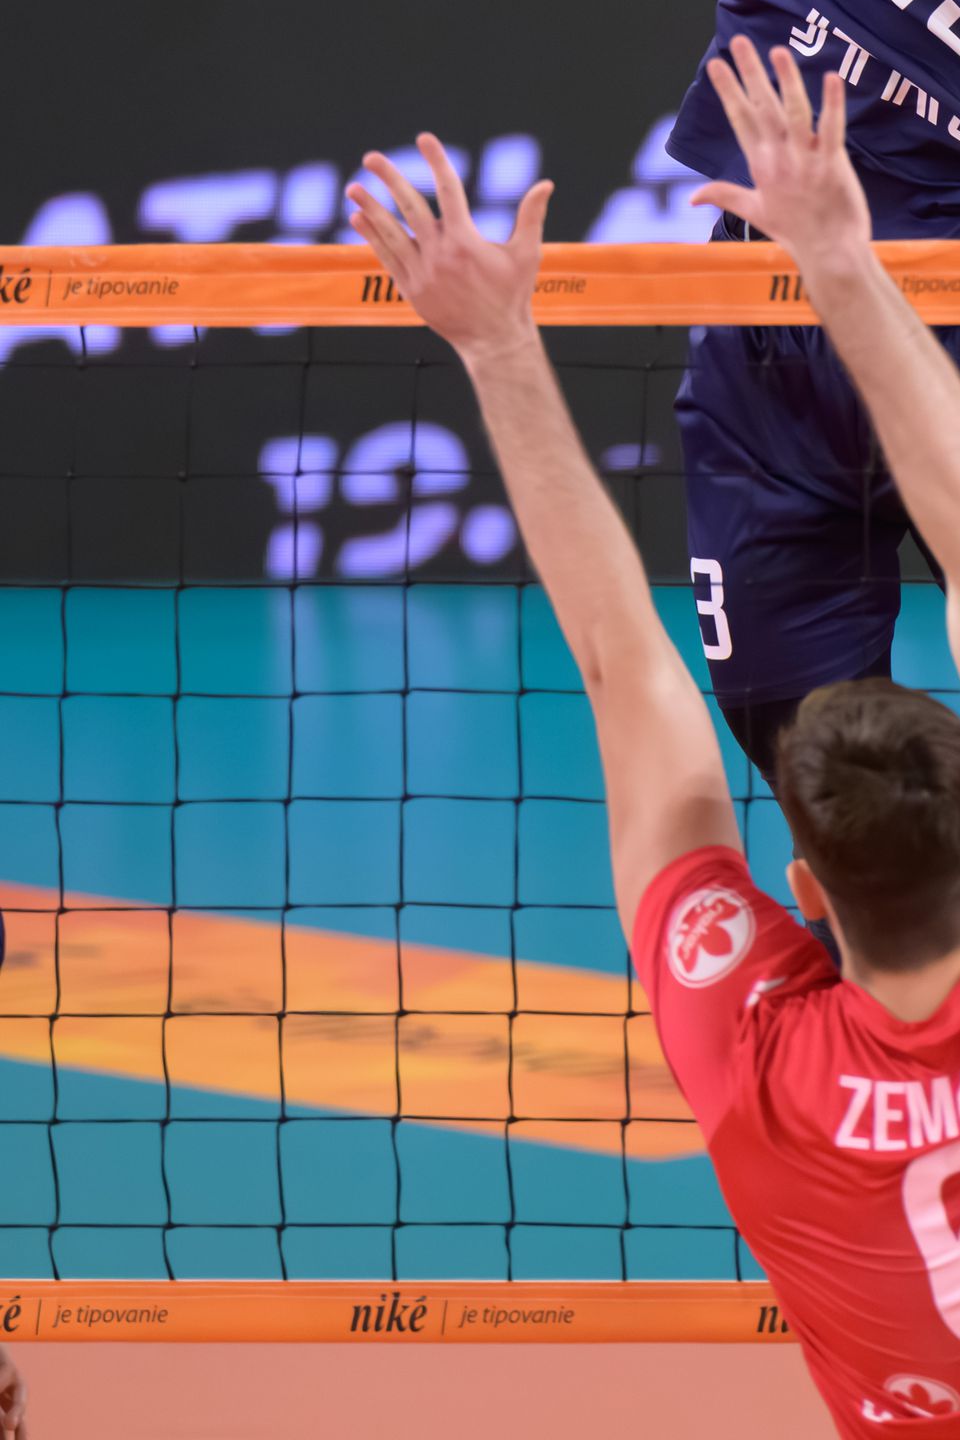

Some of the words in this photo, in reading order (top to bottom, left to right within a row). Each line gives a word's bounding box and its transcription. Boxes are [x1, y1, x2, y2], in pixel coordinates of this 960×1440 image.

[86, 276, 180, 299] tipovanie
[52, 1304, 72, 1329] je
[76, 1303, 168, 1328] tipovanie
[349, 1291, 427, 1333] niké
[458, 1305, 477, 1329] je
[482, 1304, 575, 1328] tipovanie
